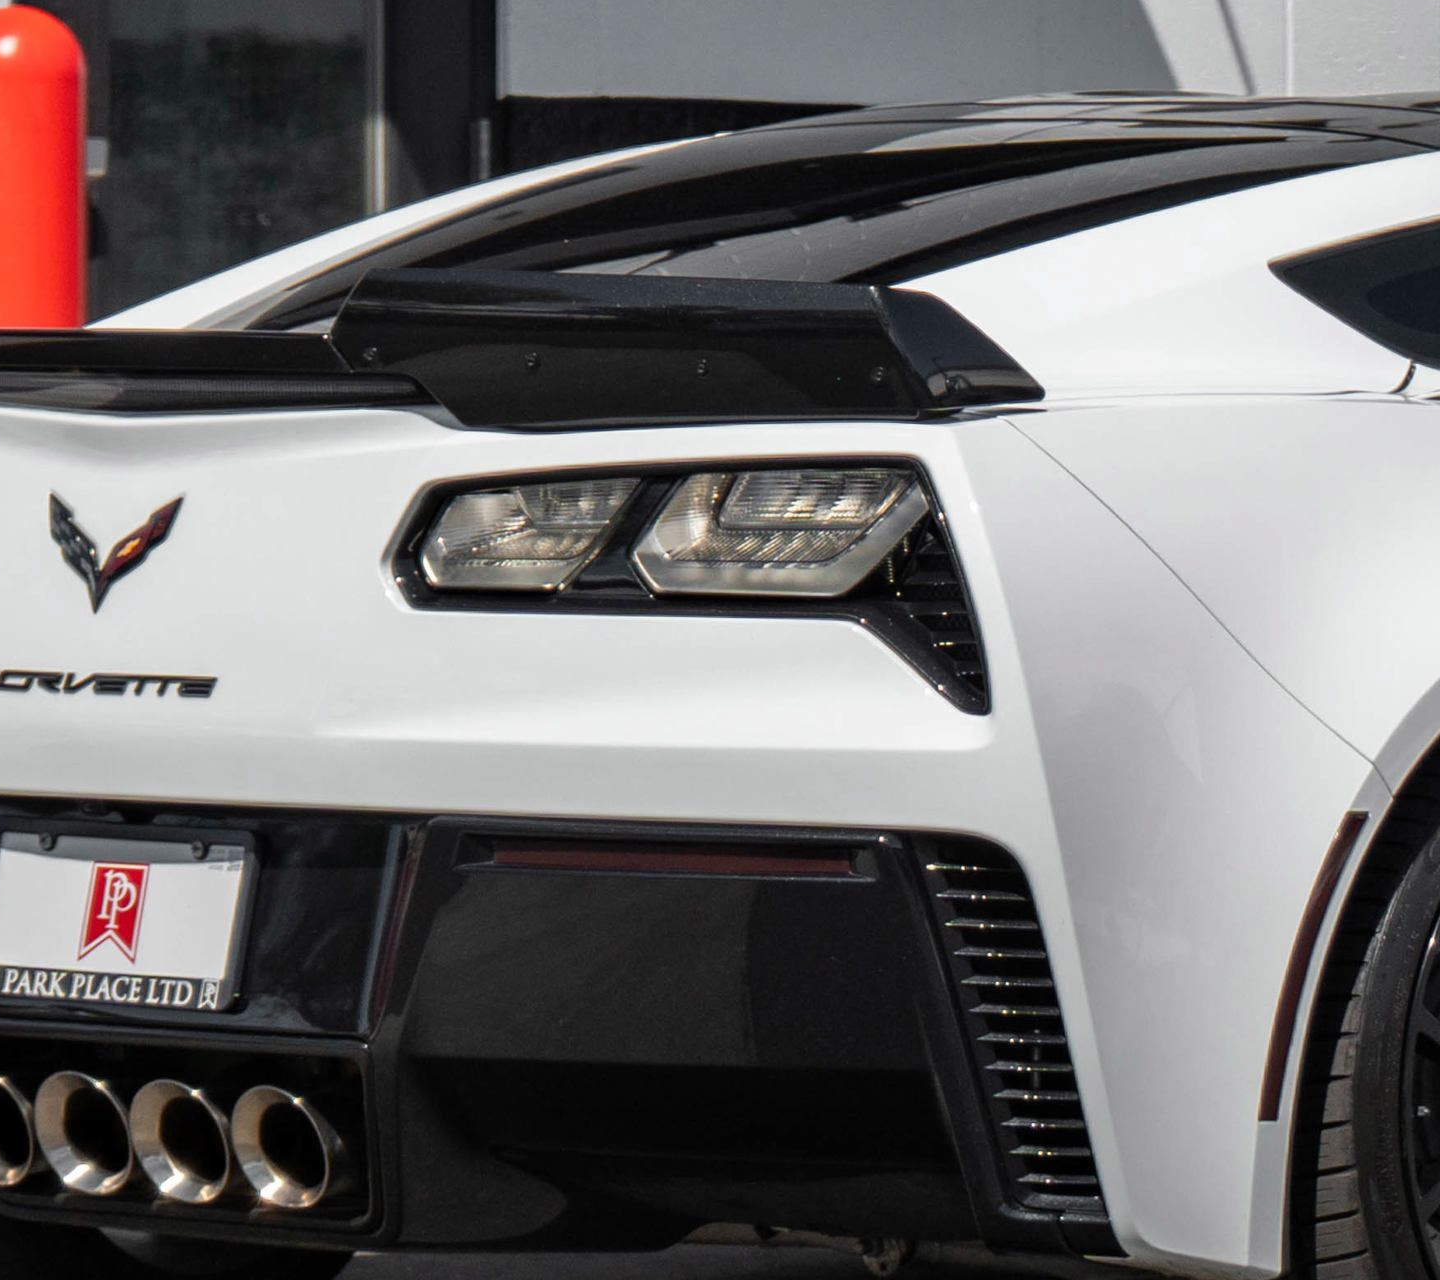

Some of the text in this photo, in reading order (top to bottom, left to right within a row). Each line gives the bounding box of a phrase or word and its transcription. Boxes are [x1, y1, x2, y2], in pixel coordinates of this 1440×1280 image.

[1, 967, 69, 999] PARK
[69, 973, 143, 1003] PLACE
[146, 978, 194, 1007] LTD
